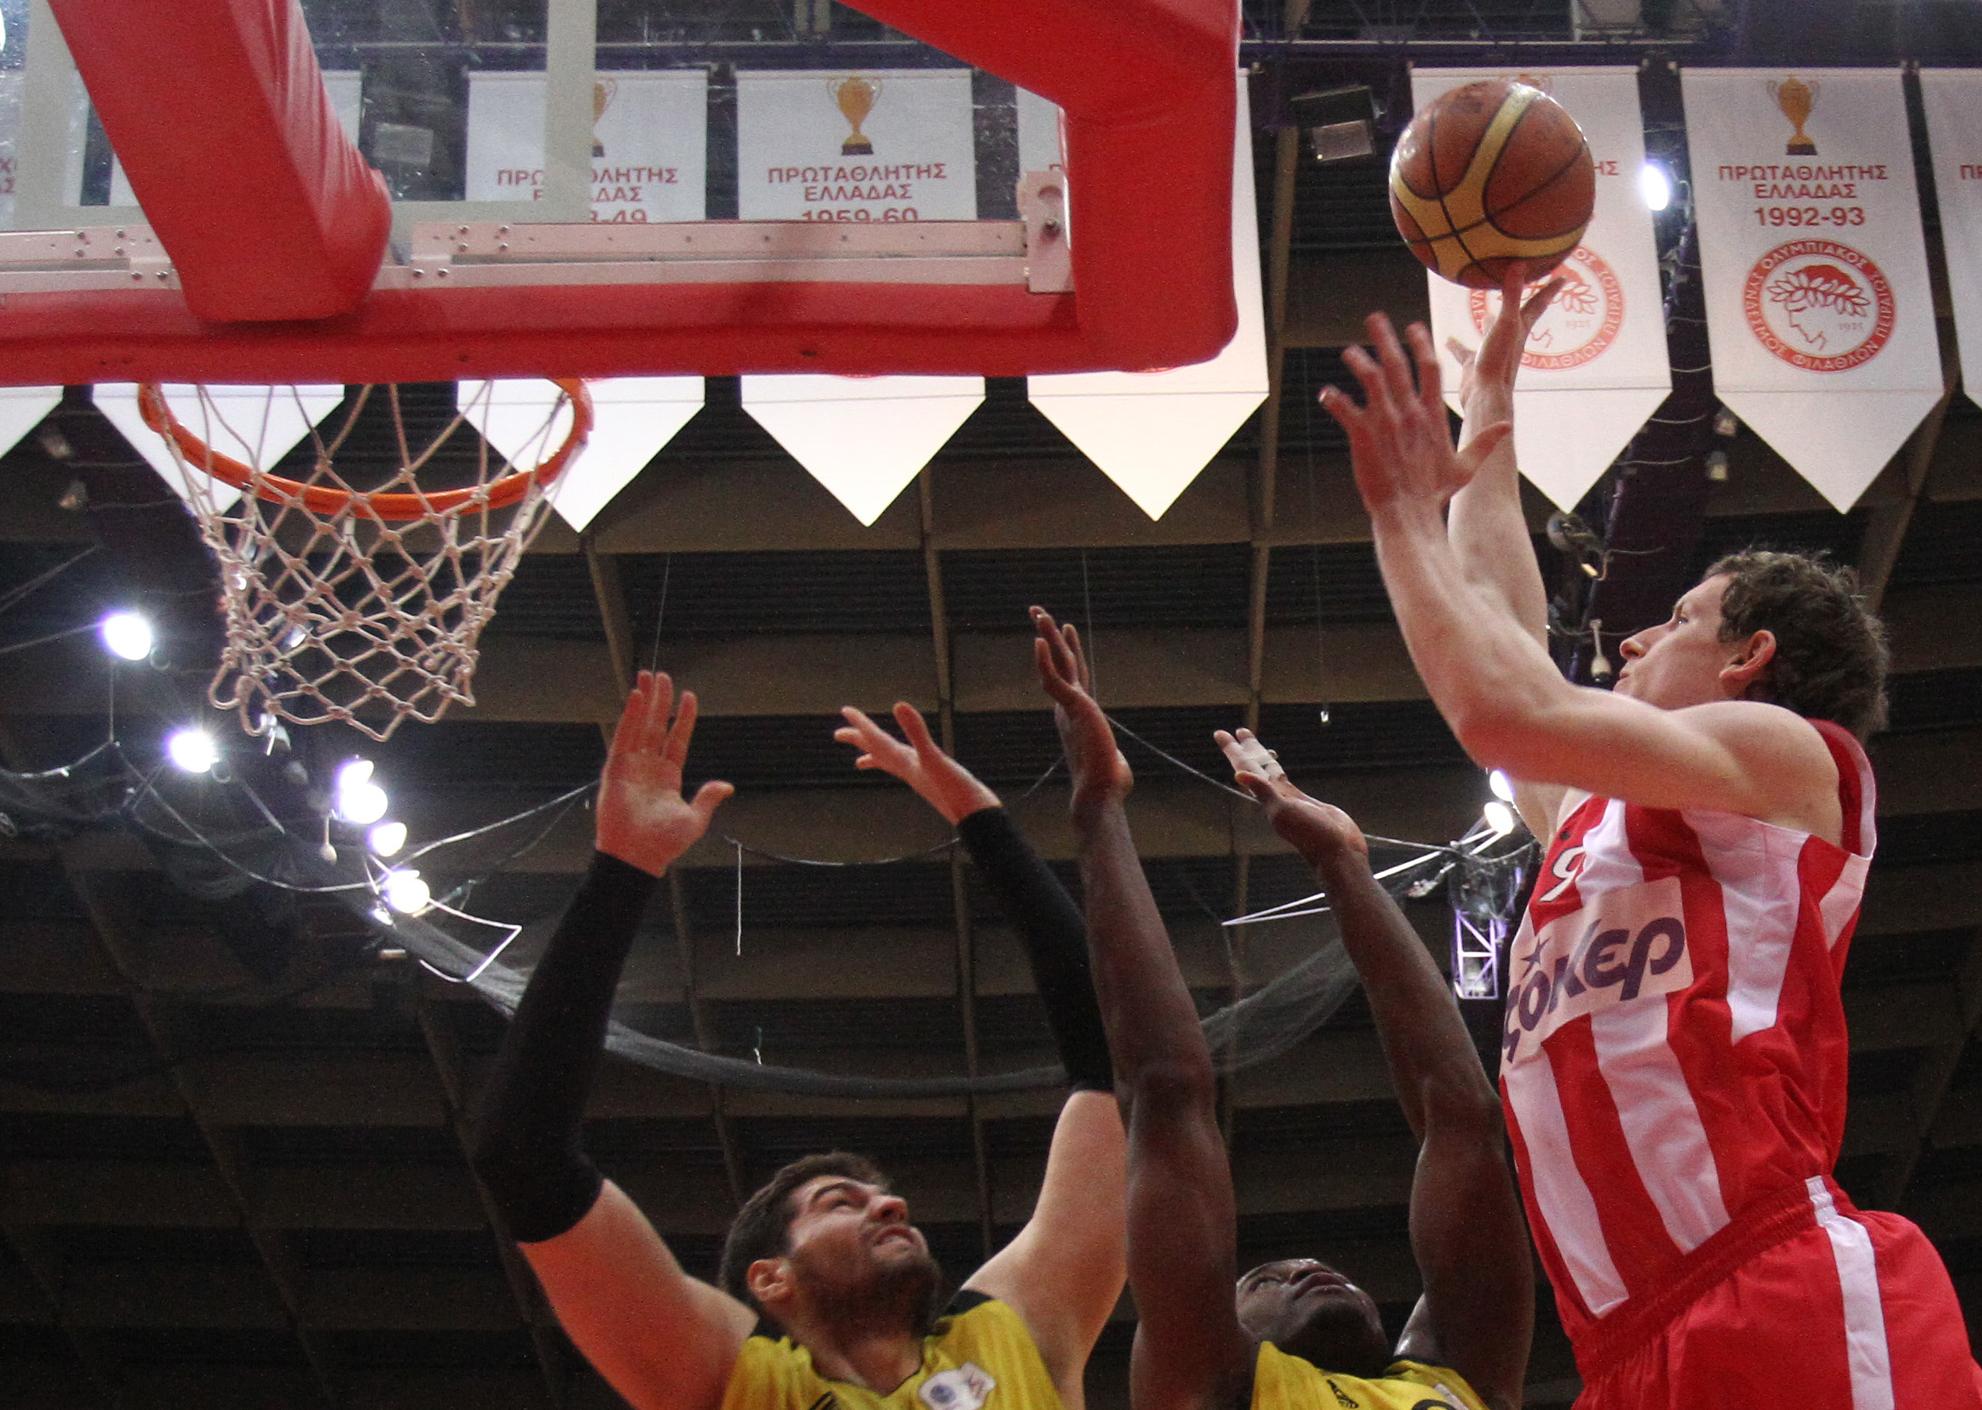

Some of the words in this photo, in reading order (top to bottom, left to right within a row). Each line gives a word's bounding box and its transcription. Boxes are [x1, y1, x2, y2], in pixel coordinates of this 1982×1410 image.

[768, 163, 947, 183] ΠΡΩΤΑΘΛΗΤΗΣ
[1718, 165, 1888, 181] ΠΡΩΤΑΘΛΗΤΗΣ
[804, 184, 913, 202] ΕΛΛΑΔΑΣ
[1754, 183, 1857, 199] ΕΛΛΑΔΑΣ
[802, 207, 918, 222] 1959-60
[1754, 207, 1865, 227] 1992-93
[1761, 241, 1868, 270] ΟΛΥΜΠΙΑΚΟΣ
[1539, 845, 1587, 903] 9
